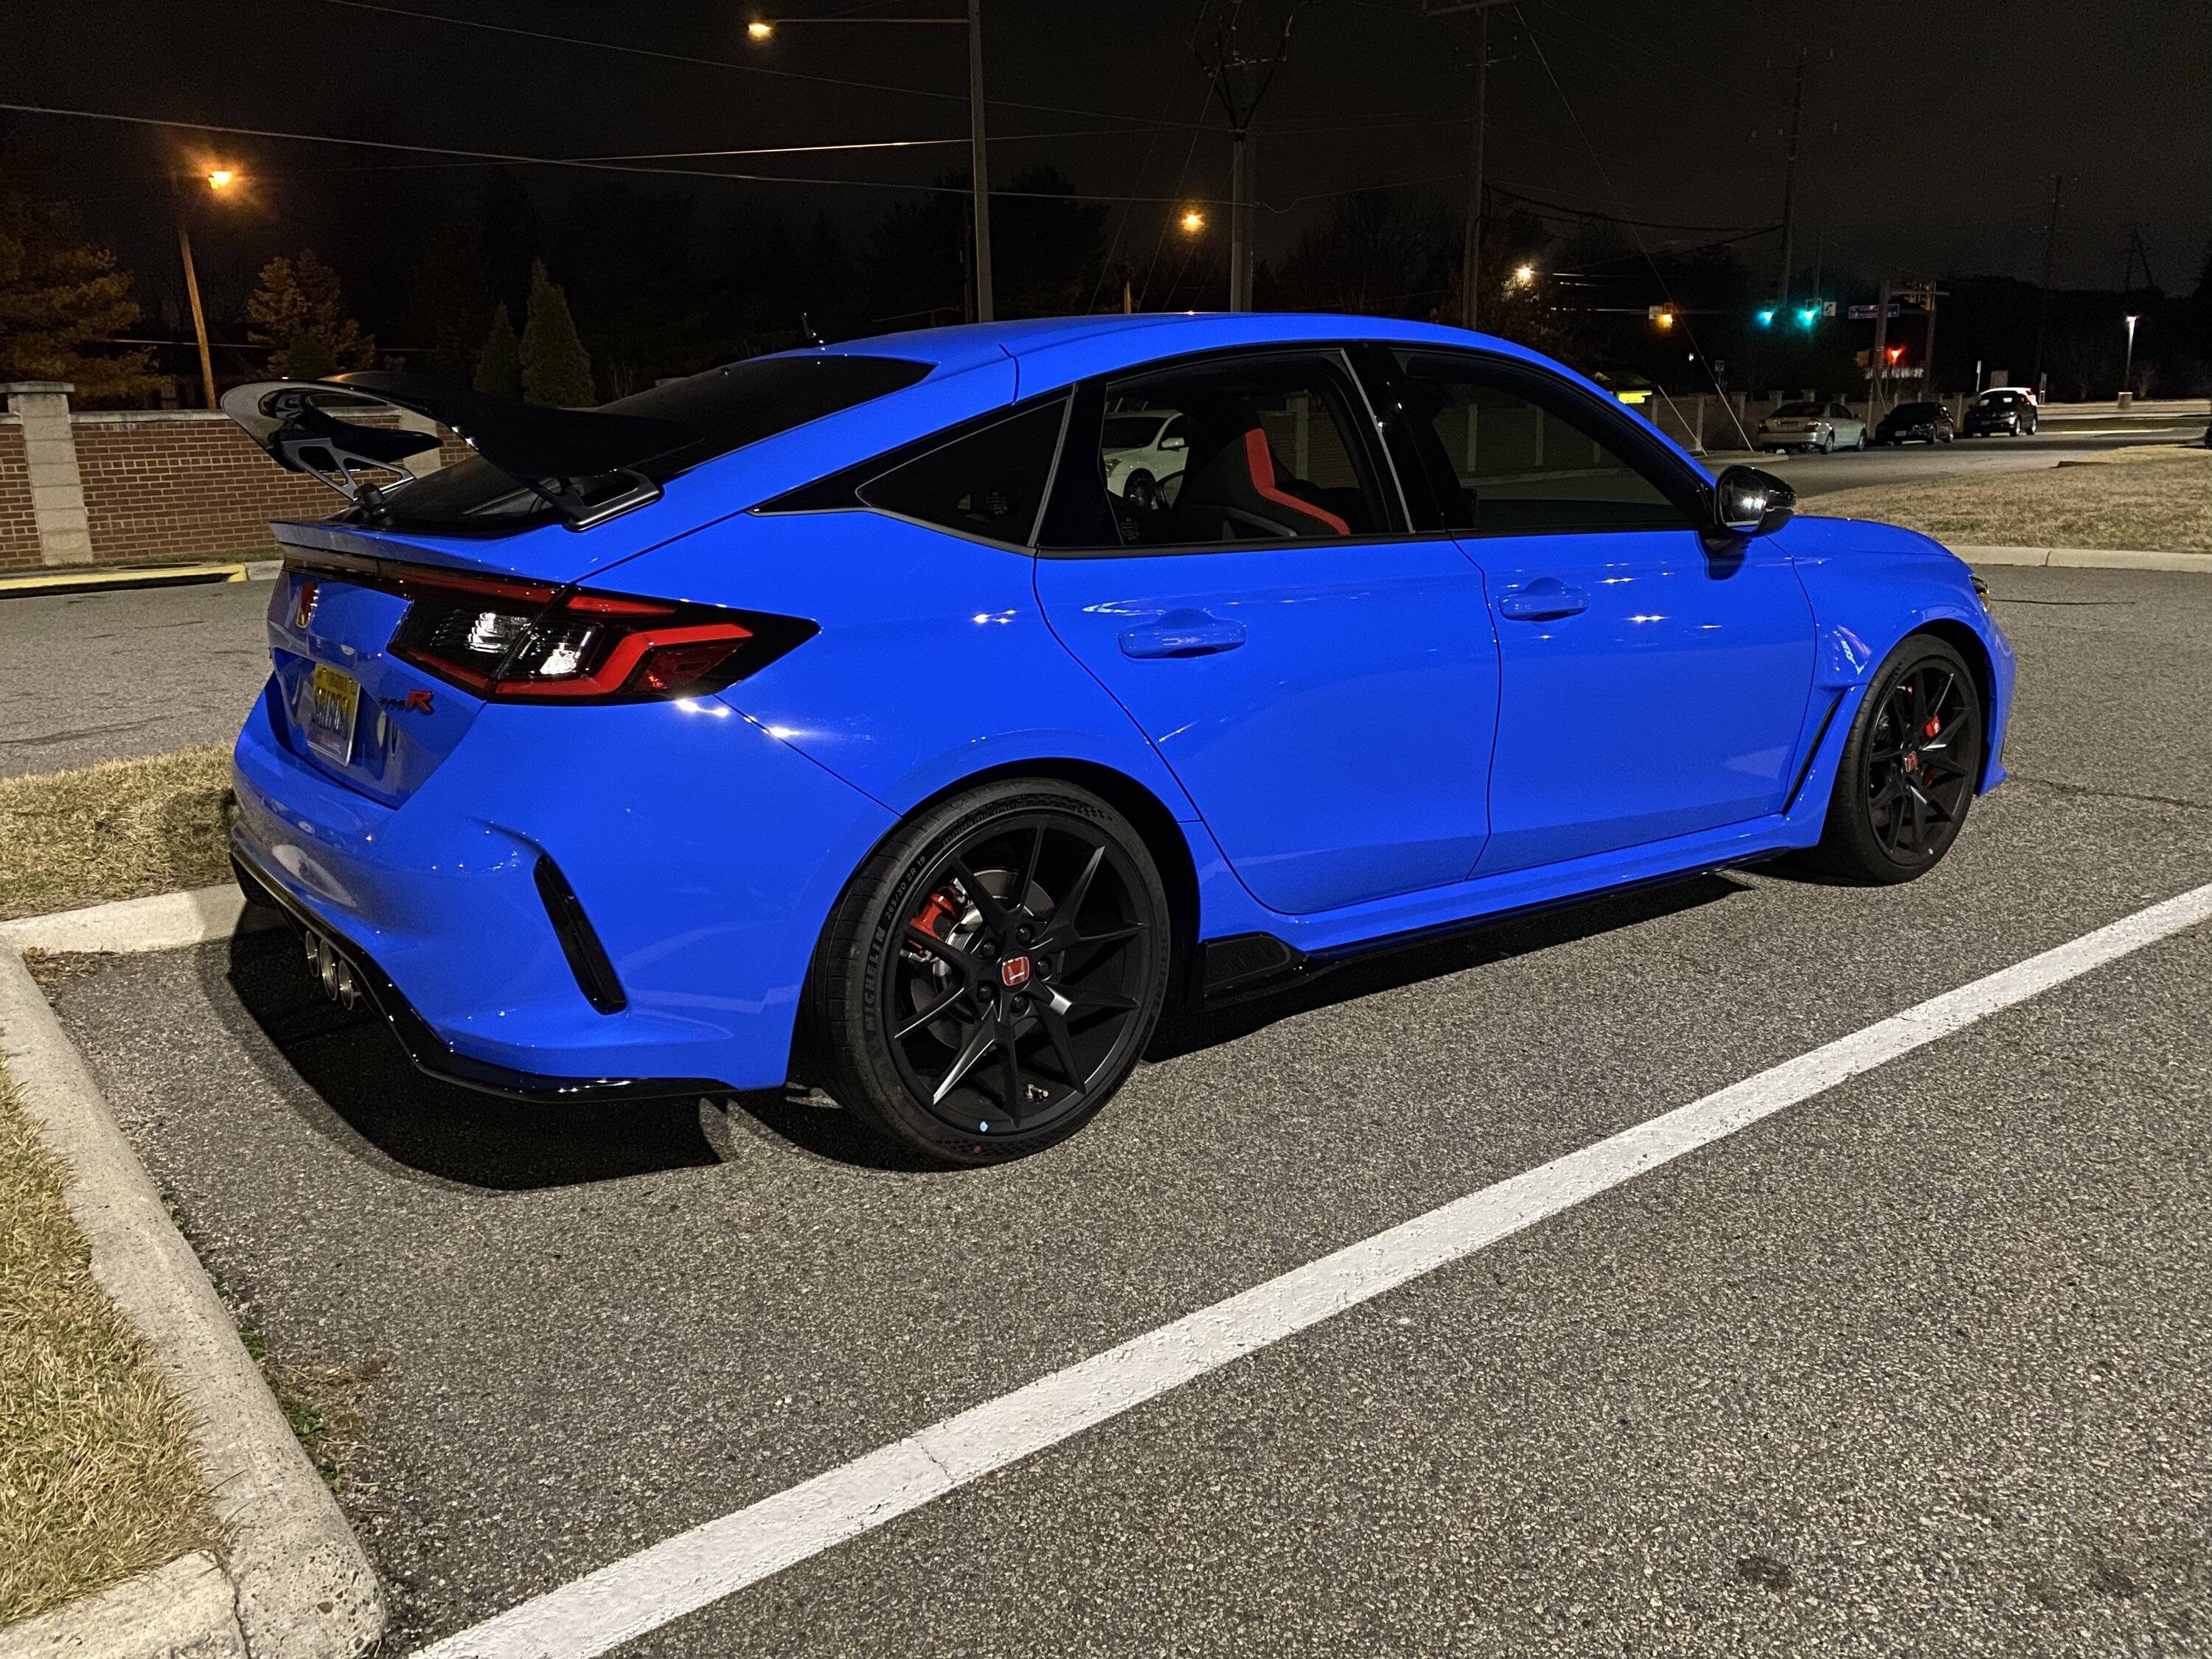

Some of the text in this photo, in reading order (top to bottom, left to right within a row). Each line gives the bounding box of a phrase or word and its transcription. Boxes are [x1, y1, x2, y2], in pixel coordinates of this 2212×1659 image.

[407, 689, 434, 714] R
[886, 856, 925, 919] 265/30 ZR 19
[865, 926, 886, 1032] MICHELIN
